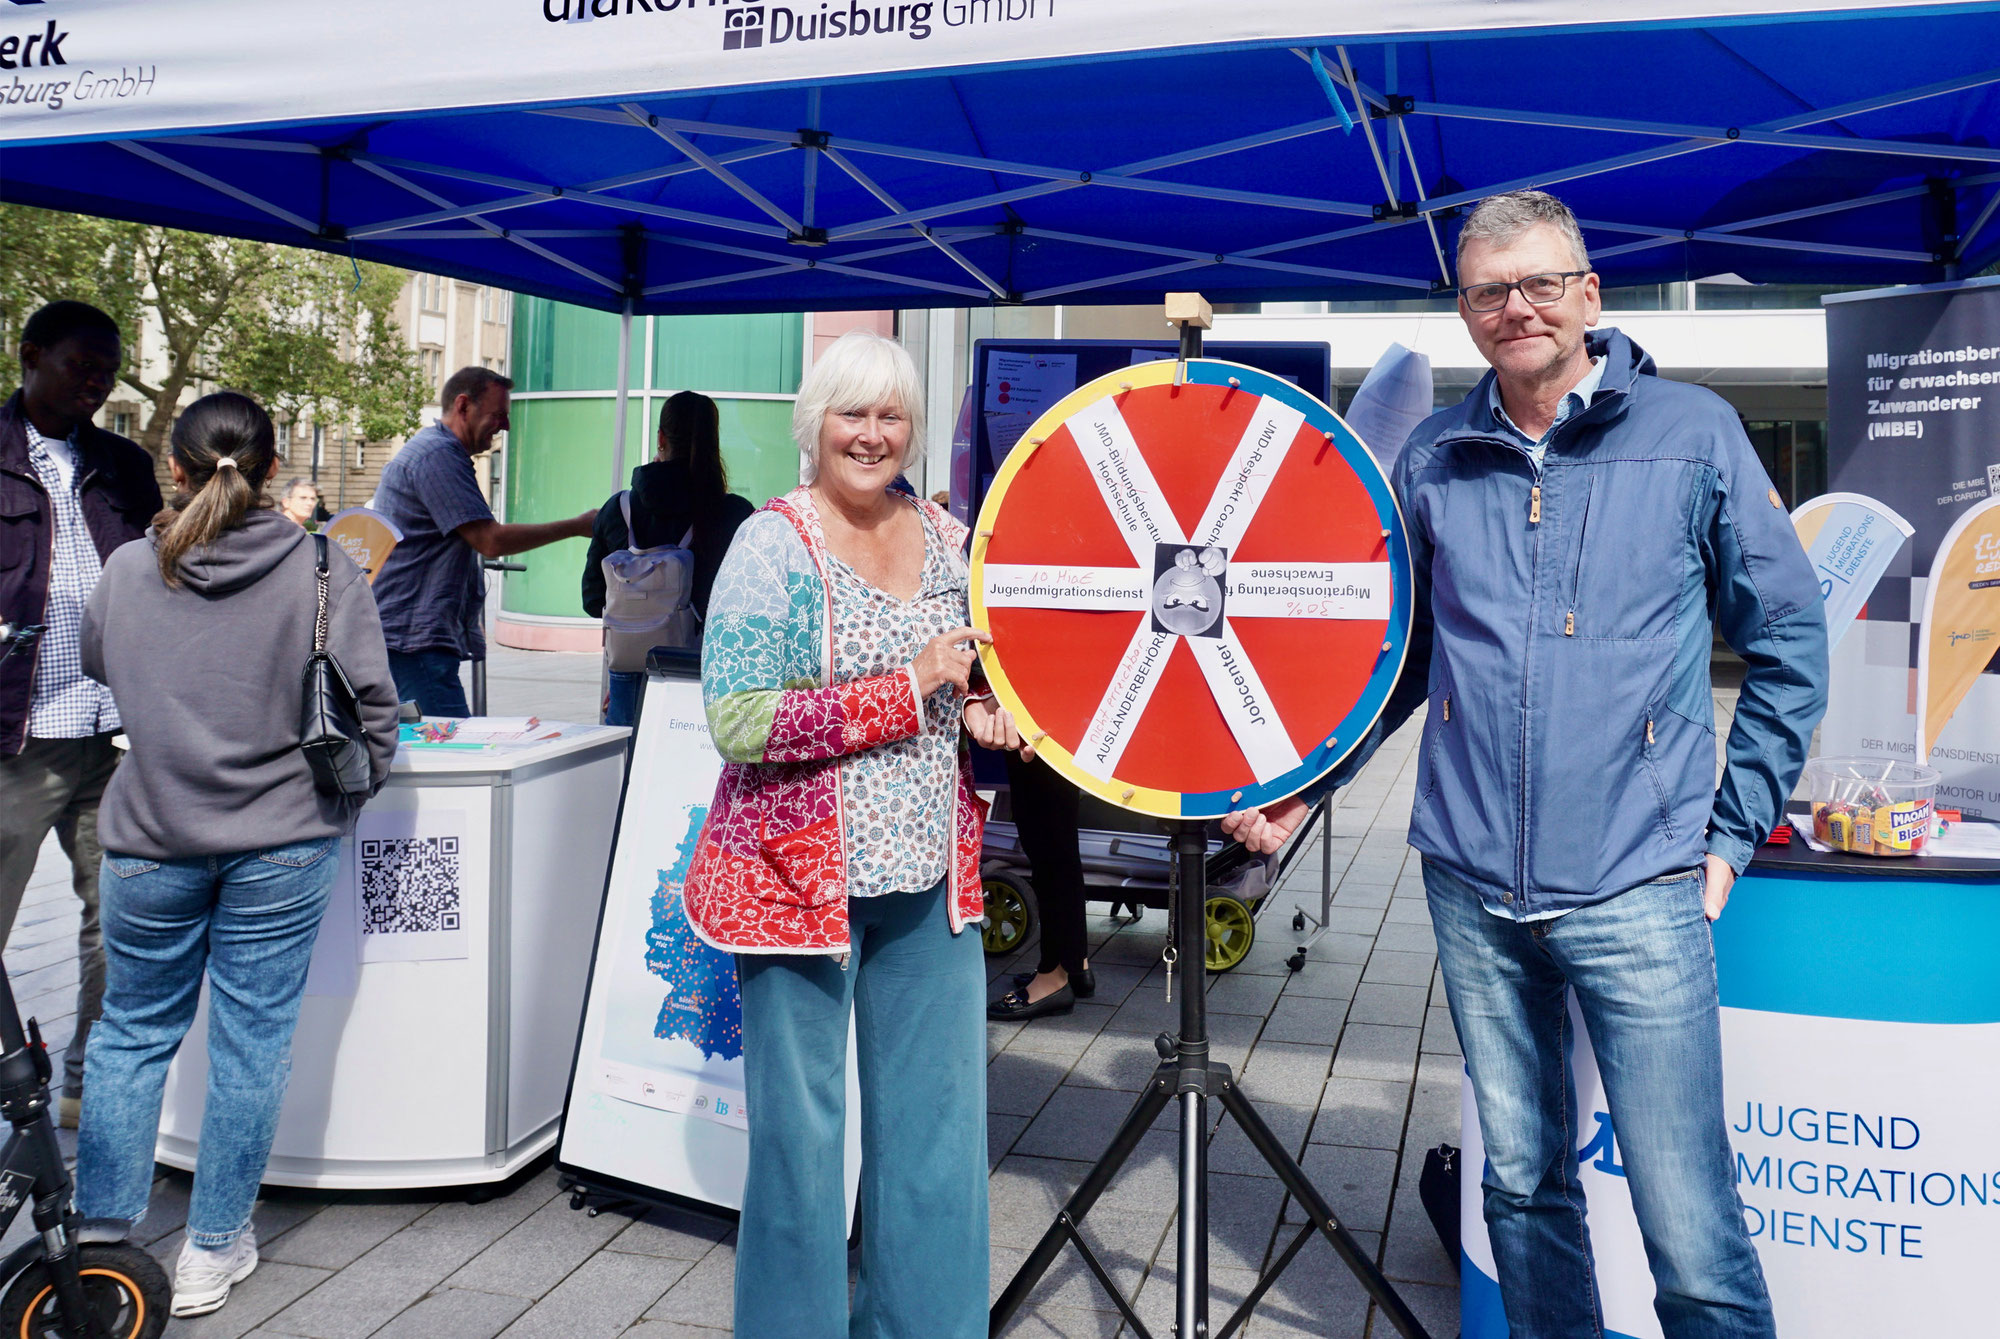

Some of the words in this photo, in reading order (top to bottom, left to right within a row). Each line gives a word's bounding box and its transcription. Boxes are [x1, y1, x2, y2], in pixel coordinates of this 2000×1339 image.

[769, 2, 933, 40] Duisburg
[74, 65, 156, 100] GmbH
[1867, 346, 2000, 370] Migrationsber
[1867, 377, 1893, 391] für
[1868, 396, 1981, 415] Zuwanderer
[1867, 420, 1924, 440] (MBE)
[1229, 419, 1277, 501] JMD-Respekt
[1093, 421, 1163, 544] JMD-Bildungsberatu
[1952, 481, 1966, 490] DIE
[1967, 478, 1985, 487] MBE
[1097, 460, 1138, 532] Hochschule
[1937, 496, 1953, 505] DER
[1954, 489, 1987, 502] CARITAS
[1826, 526, 1852, 564] JUGEND
[1835, 514, 1875, 570] MIGRATIONS
[1845, 538, 1875, 577] DIENSTE
[1251, 569, 1333, 581] Erwachsene
[990, 584, 1143, 599] Jugendmigrationsdienst
[1238, 583, 1371, 599] Migrationsberatung
[1216, 644, 1266, 726] Jobcenter
[669, 719, 695, 731] Einen
[1861, 738, 1883, 750] DER
[1892, 803, 1930, 828] MAOAM
[1898, 825, 1927, 842] Bloxx
[1734, 1101, 1920, 1150] JUGEND
